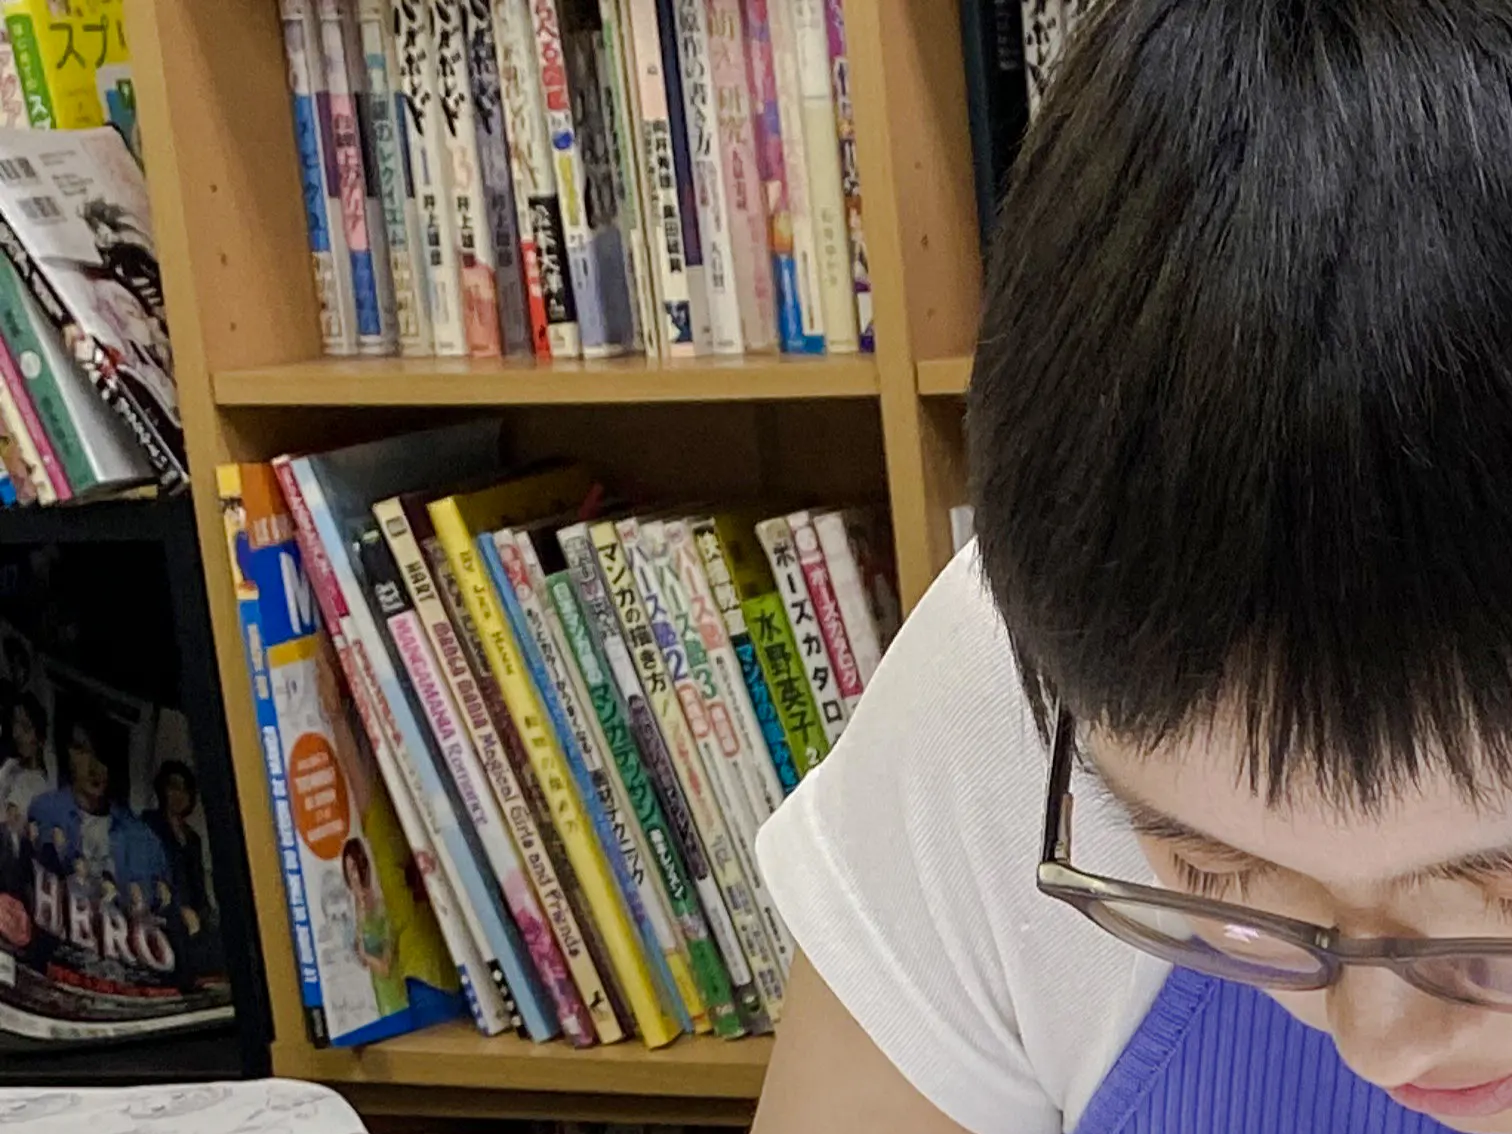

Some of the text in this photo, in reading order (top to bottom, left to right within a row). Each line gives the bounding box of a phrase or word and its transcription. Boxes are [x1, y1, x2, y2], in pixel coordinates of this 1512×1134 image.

[597, 542, 667, 694] マンガの描き方
[772, 541, 842, 740] ポーズカタロ
[447, 741, 489, 827] Romance
[477, 732, 520, 802] Magical
[509, 804, 534, 850] Girls
[528, 853, 552, 888] and
[543, 886, 580, 958] Friends
